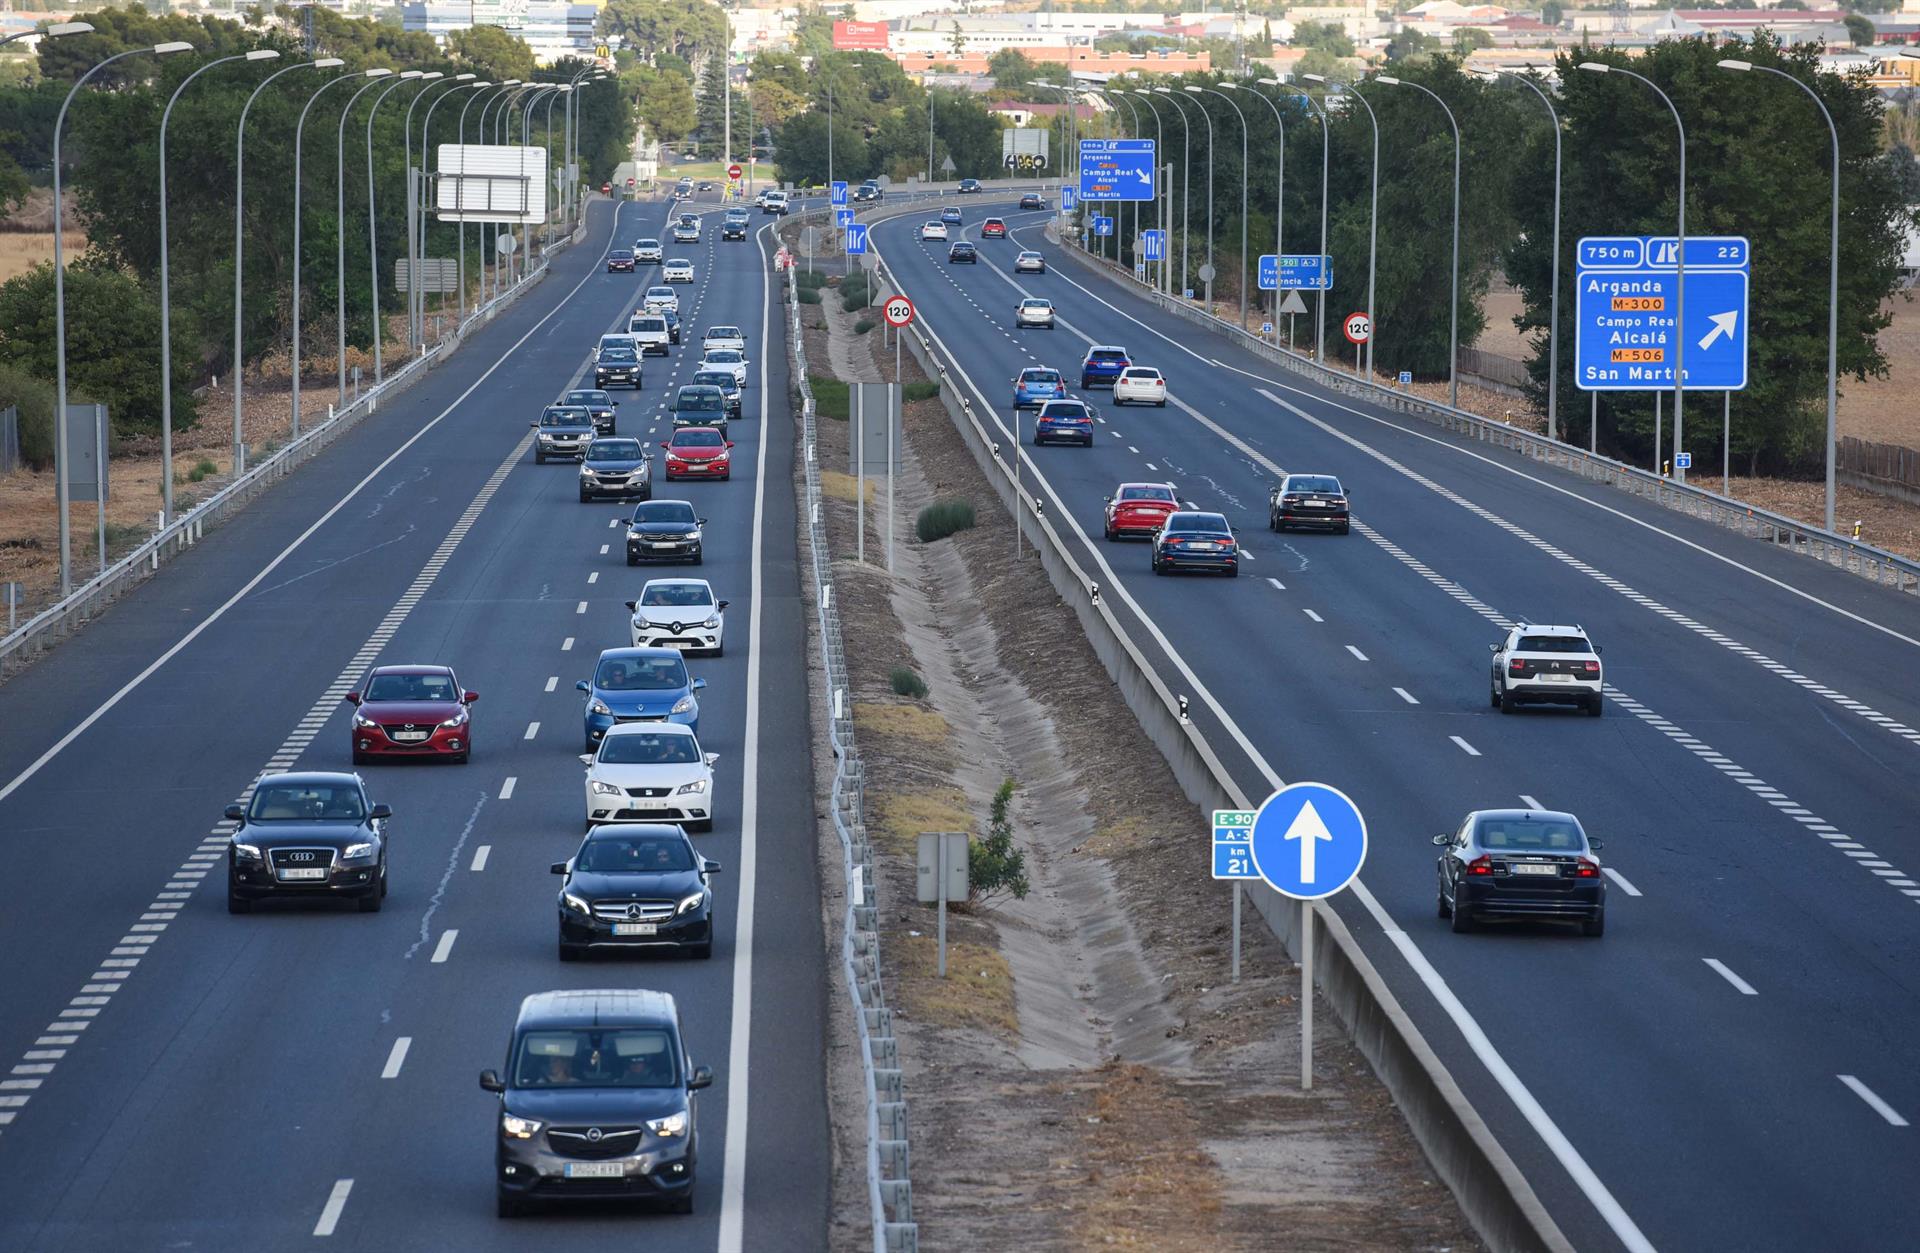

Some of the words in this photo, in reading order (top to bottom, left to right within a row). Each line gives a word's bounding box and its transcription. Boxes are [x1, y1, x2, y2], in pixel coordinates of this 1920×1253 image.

[1083, 154, 1112, 162] Arganda
[1083, 168, 1111, 177] Campo
[1115, 168, 1134, 176] Real
[1587, 247, 1619, 258] 750
[1623, 250, 1635, 258] m
[1718, 247, 1740, 258] 22
[1587, 280, 1662, 296] Arganda
[1613, 299, 1662, 310] M-300
[888, 307, 910, 316] 120
[1596, 316, 1641, 329] Campo
[1609, 331, 1667, 344] Alcalá
[1612, 350, 1662, 361] M-506
[1586, 367, 1619, 380] San
[1219, 814, 1256, 825] E-90
[1225, 829, 1250, 840] A-3
[1230, 848, 1246, 856] km
[1228, 858, 1248, 874] 21
